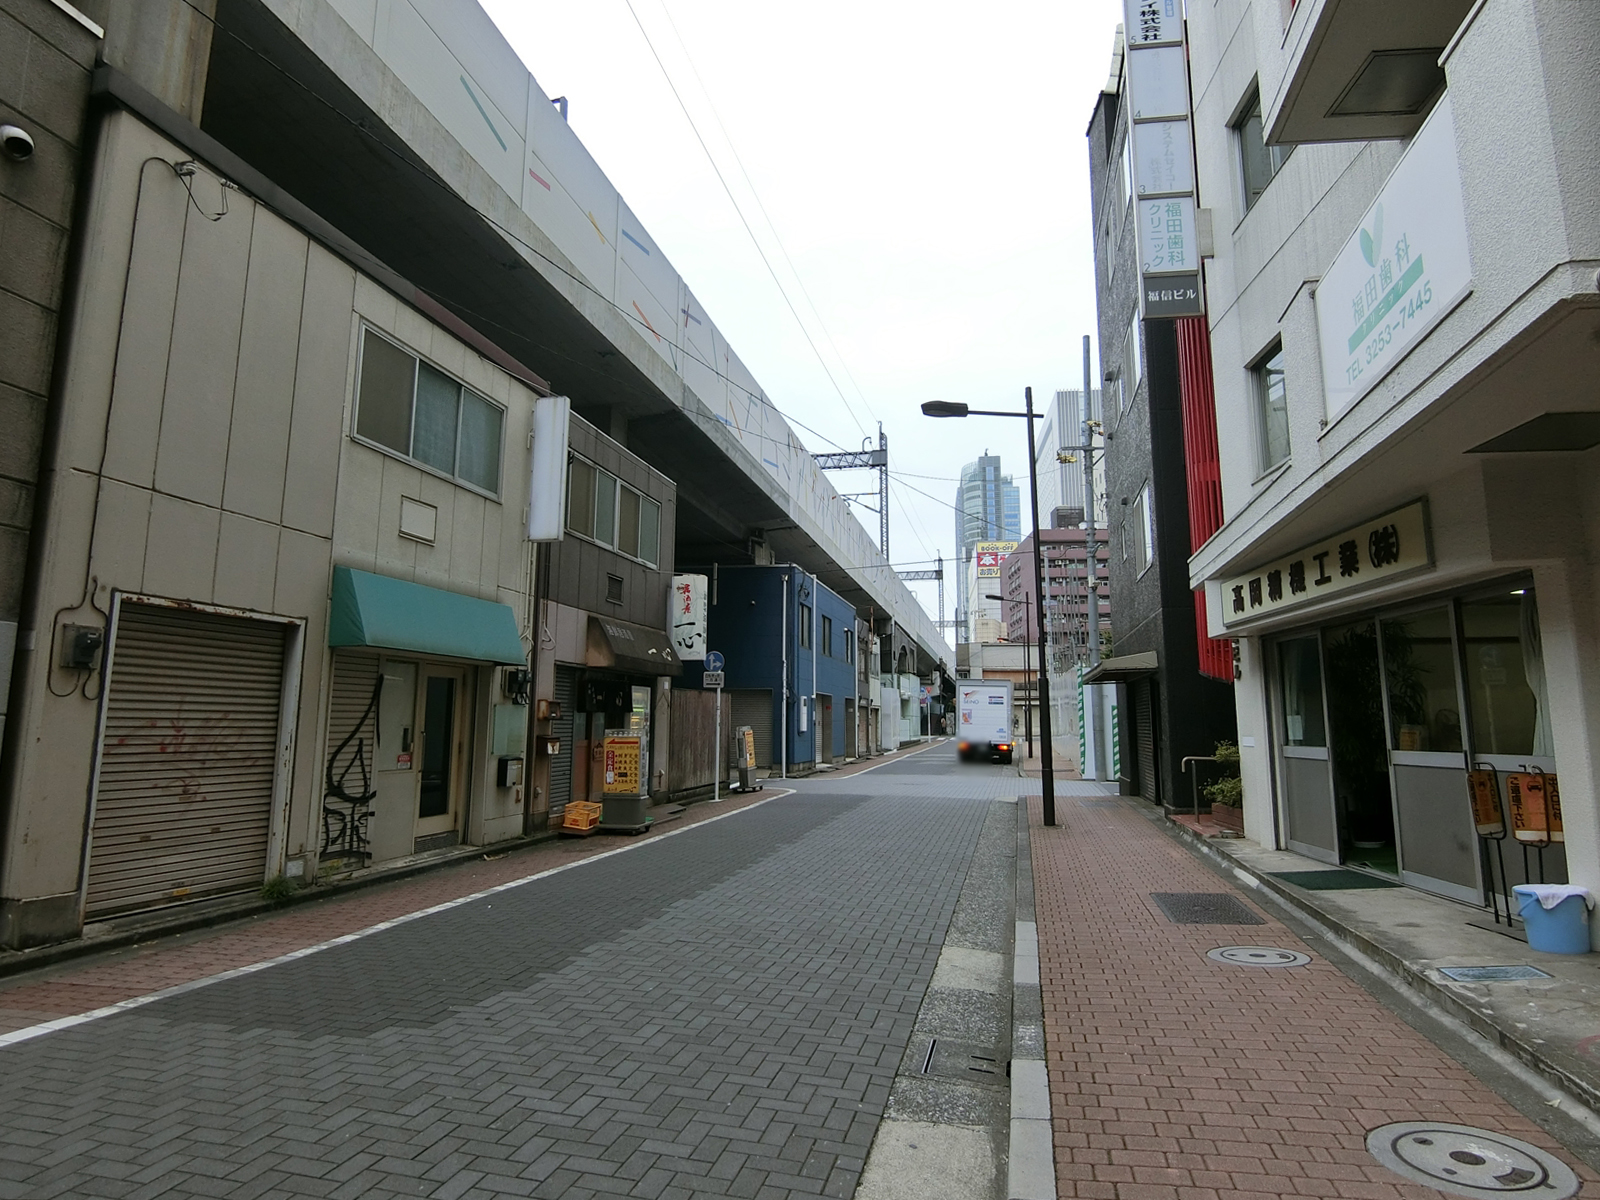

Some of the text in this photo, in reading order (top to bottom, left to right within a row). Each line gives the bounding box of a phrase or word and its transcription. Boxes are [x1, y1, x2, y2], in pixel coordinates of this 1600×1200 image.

[1140, 0, 1162, 41] イ株式会社
[1130, 35, 1137, 44] 5
[1135, 110, 1142, 118] 4
[1162, 123, 1176, 191] システムセイコー
[1139, 184, 1146, 194] 3
[1149, 203, 1165, 268] クリニック
[1165, 202, 1186, 266] 福田歯科
[1143, 262, 1151, 272] 2
[1352, 232, 1411, 326] 福田歯科
[1147, 288, 1197, 302] 福信ビル
[1361, 280, 1404, 334] クリニック
[1345, 279, 1433, 385] TEL 3253-7445
[980, 544, 1014, 552] BOOK-OFF
[680, 582, 692, 615] 居酒屋
[673, 621, 702, 650] 一心
[1509, 776, 1526, 828] ご遠慮下さい
